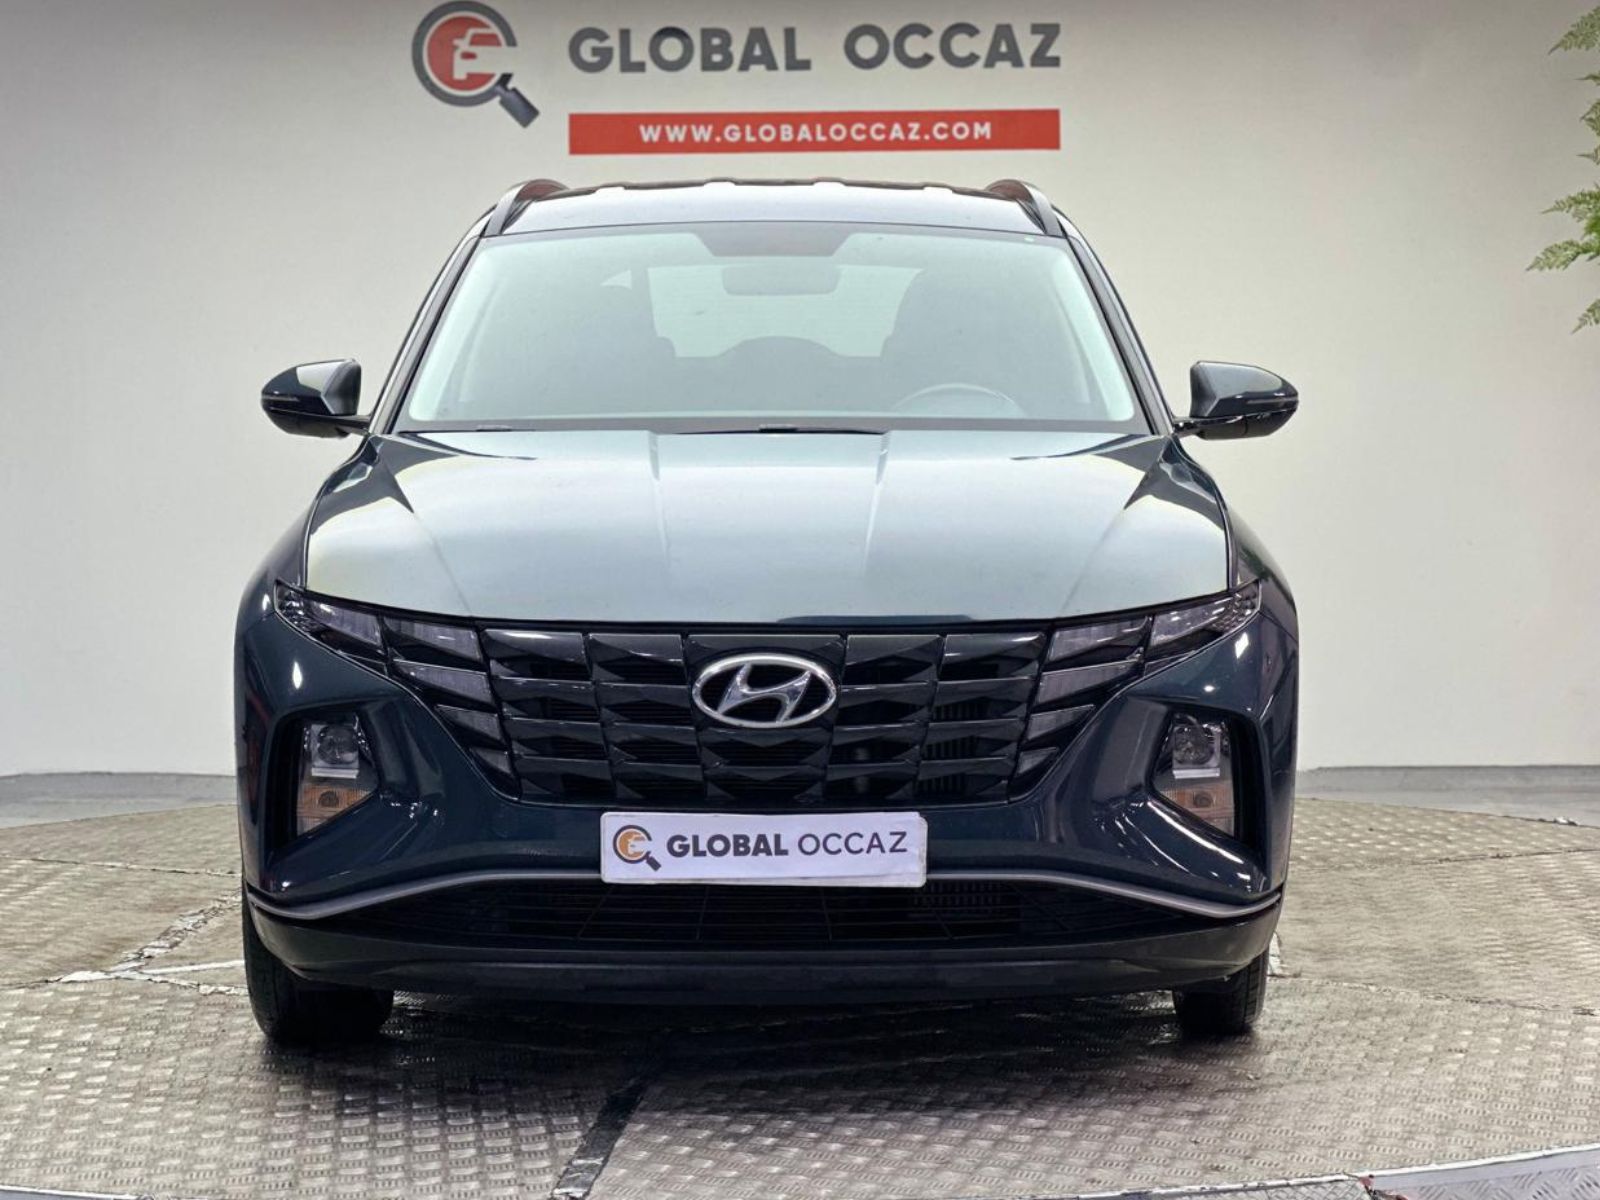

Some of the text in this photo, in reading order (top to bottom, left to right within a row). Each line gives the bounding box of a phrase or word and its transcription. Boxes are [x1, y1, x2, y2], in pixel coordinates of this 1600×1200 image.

[568, 23, 1061, 72] GLOBAL OCCAZ
[640, 122, 992, 142] WWW.GLOBALOCCAZ.COM
[667, 832, 907, 857] GLOBAL OCCAZ
